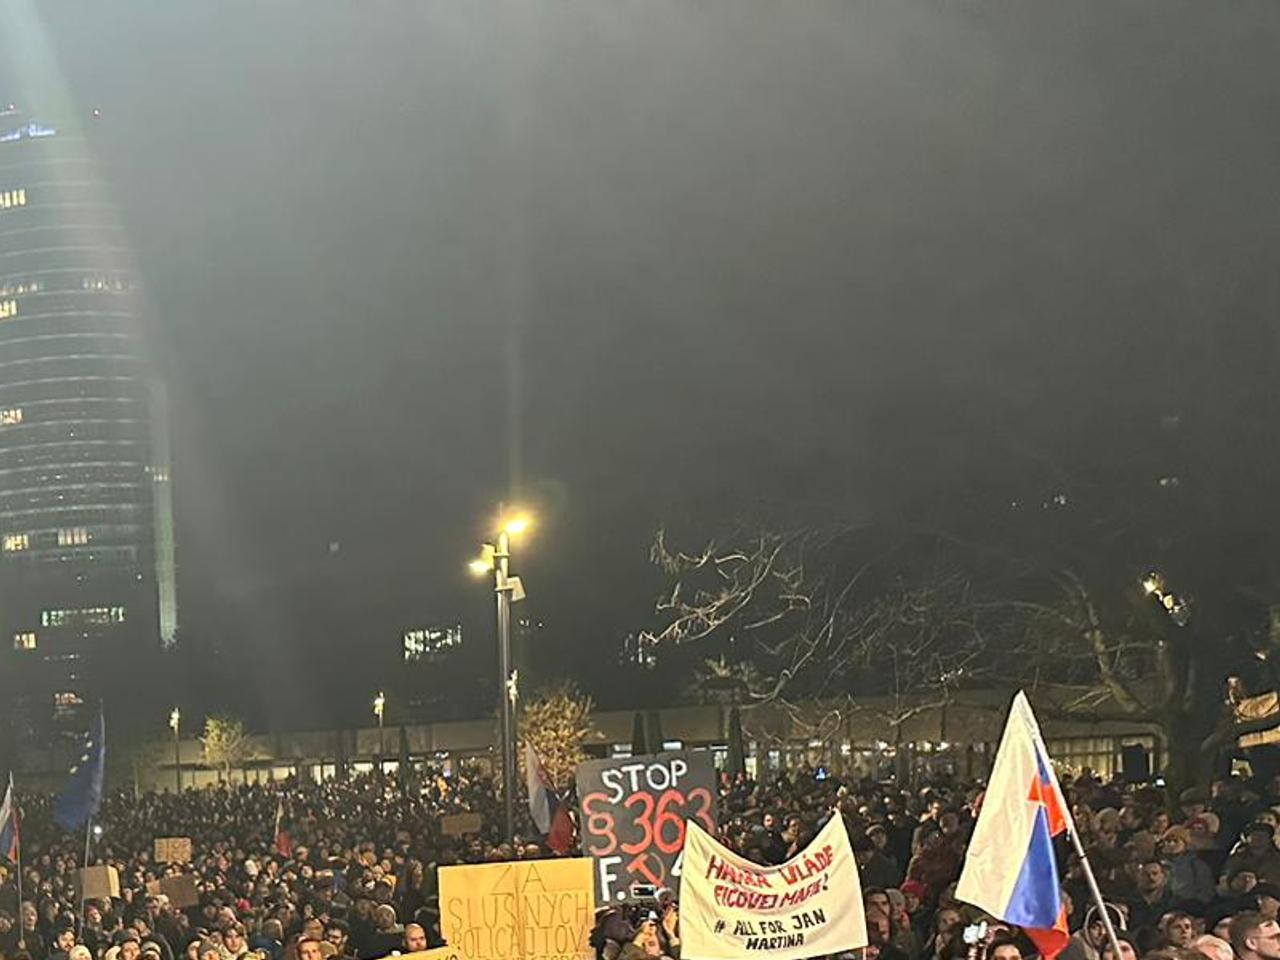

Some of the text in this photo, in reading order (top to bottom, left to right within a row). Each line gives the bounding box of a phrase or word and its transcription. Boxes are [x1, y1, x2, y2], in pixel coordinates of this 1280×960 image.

[601, 760, 687, 804] STOP
[734, 920, 757, 935] ALL
[760, 920, 787, 935] FOR
[791, 908, 826, 930] JAN
[746, 933, 804, 950] MARTINA
